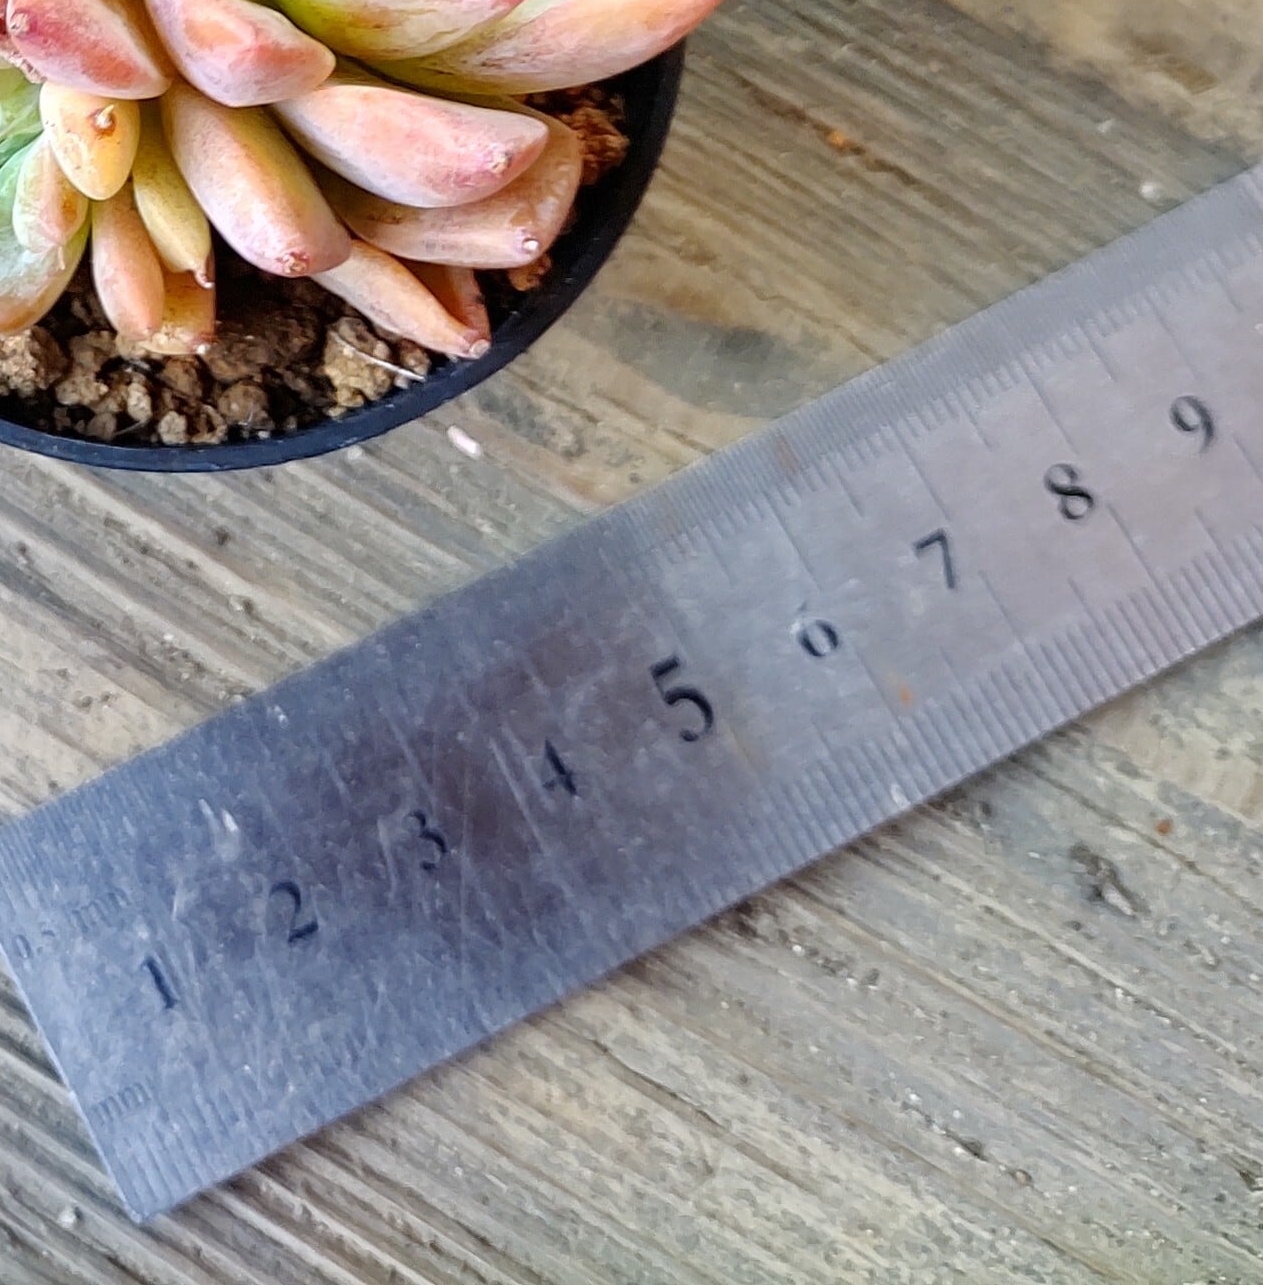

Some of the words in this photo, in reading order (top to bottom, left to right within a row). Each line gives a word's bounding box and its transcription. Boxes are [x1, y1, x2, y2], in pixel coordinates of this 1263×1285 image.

[141, 956, 178, 1010] 1
[270, 880, 319, 944] 2
[407, 810, 448, 872] 3
[541, 738, 578, 797] 4
[651, 655, 714, 743] 5
[912, 528, 957, 590] 7
[1042, 462, 1095, 521] 8
[1169, 394, 1216, 454] 9
